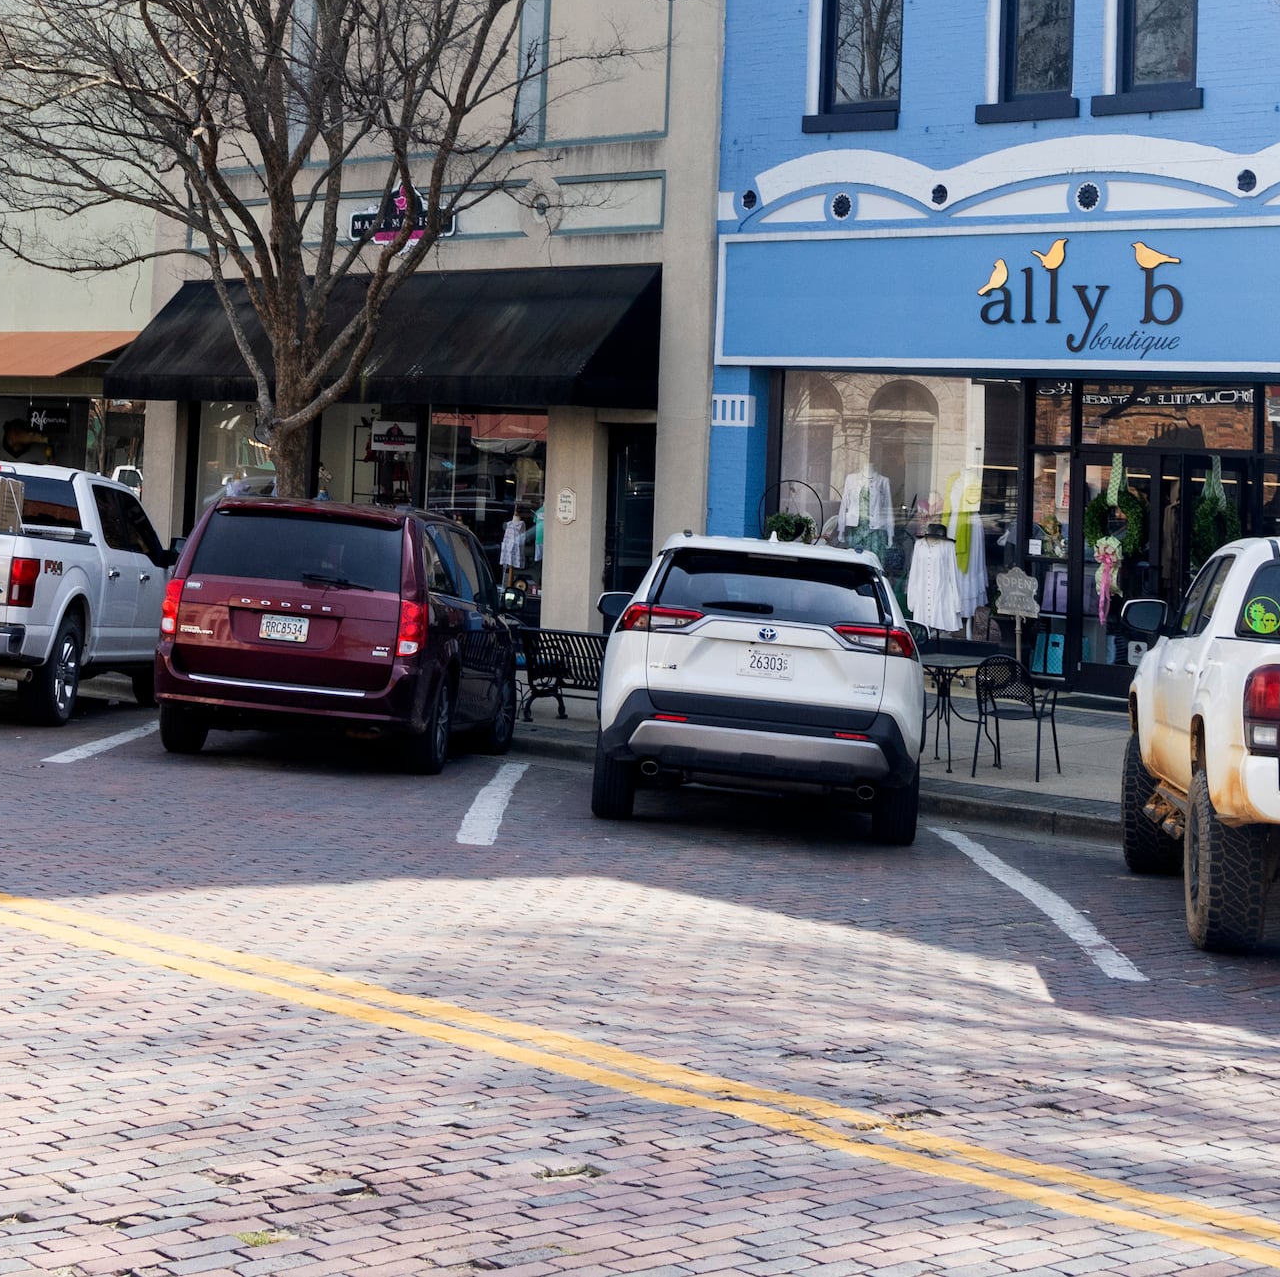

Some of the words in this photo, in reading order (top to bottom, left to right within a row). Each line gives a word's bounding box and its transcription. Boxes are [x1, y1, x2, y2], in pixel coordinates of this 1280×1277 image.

[979, 266, 1111, 354] ally
[1139, 266, 1184, 326] b
[1088, 323, 1181, 360] boutique
[44, 558, 63, 575] FX4
[1001, 577, 1032, 590] OPEN
[240, 597, 332, 612] DODGE
[264, 620, 304, 636] RRC8534
[749, 654, 783, 672] 26303
